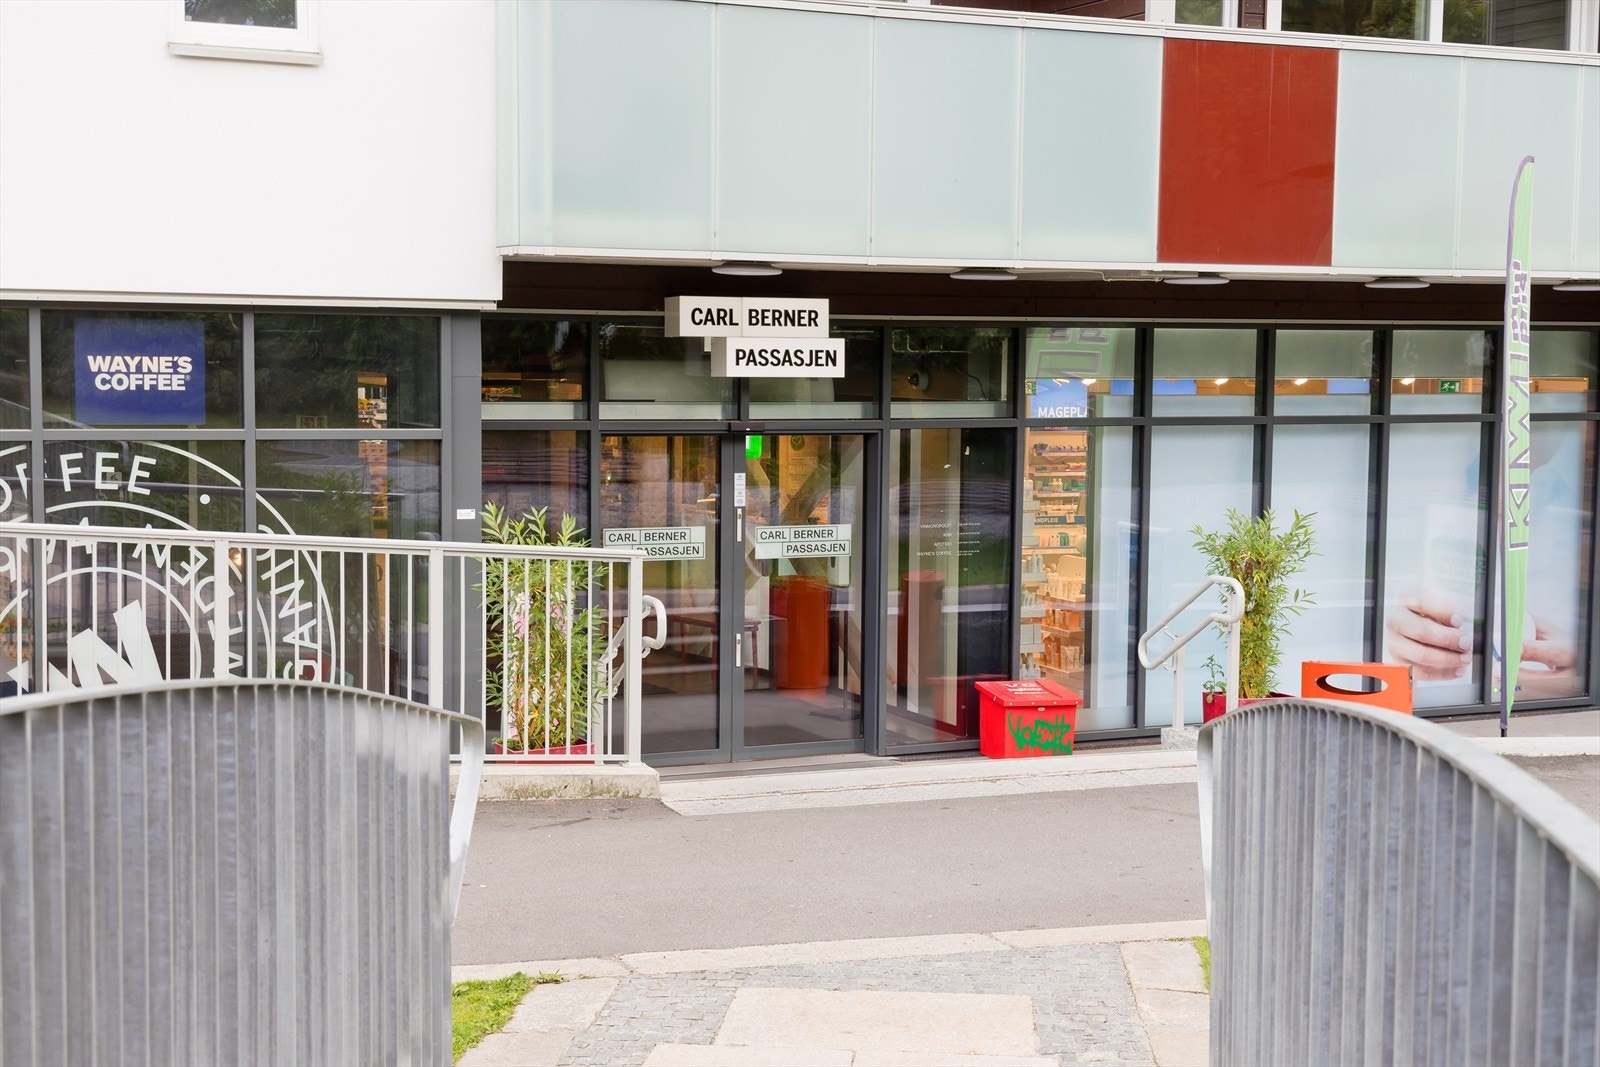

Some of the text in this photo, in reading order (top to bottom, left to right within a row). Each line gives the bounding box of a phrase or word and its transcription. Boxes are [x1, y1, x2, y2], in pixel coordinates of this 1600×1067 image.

[690, 307, 819, 327] CARL BERNER
[87, 355, 193, 374] WAYNE'S
[735, 348, 837, 367] PASSASJEN
[1507, 352, 1531, 550] KIWI
[608, 531, 687, 543] CARL BERNER
[760, 529, 834, 541] CARL BERNER
[786, 543, 846, 554] PASSASJEN
